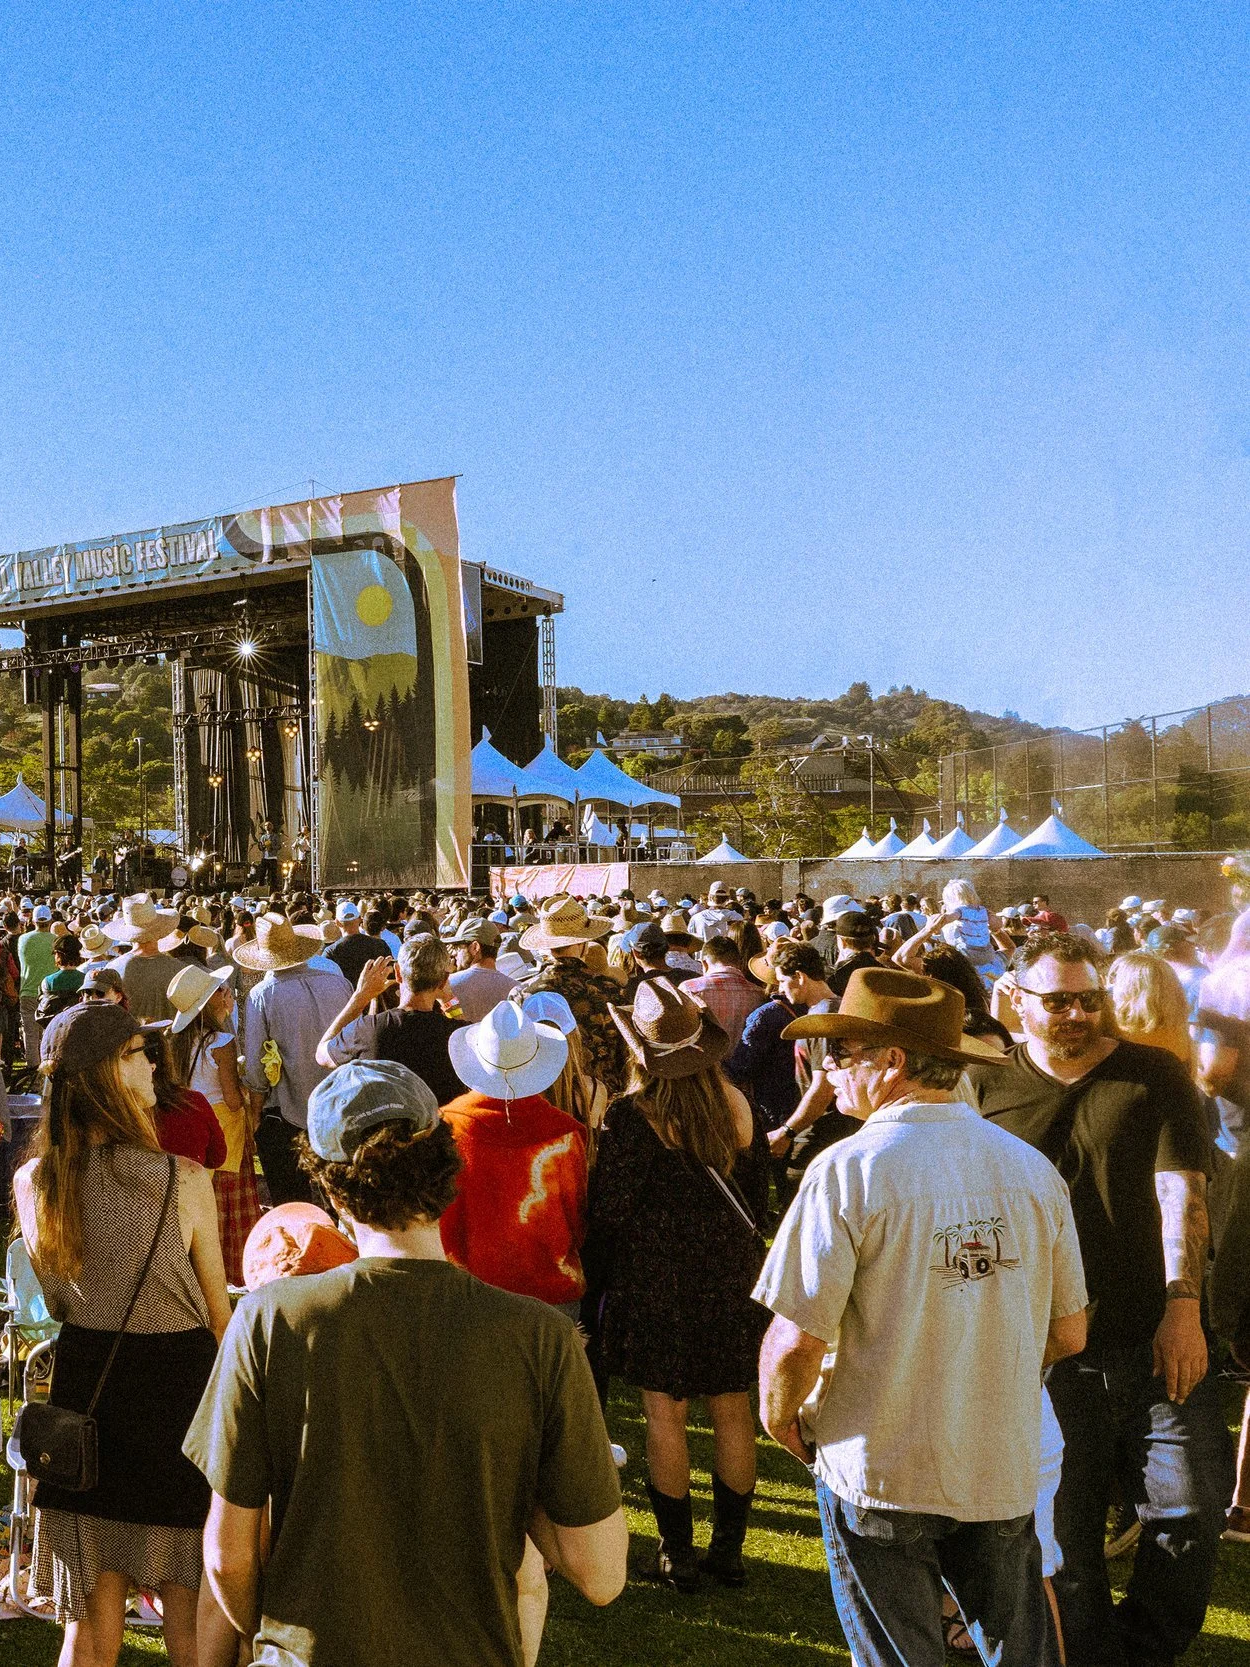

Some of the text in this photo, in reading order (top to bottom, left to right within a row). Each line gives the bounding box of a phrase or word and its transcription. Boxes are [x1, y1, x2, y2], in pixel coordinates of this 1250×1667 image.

[12, 554, 72, 591] VALLEY
[75, 543, 134, 582] MUSIC
[135, 528, 222, 572] FESTIVAL
